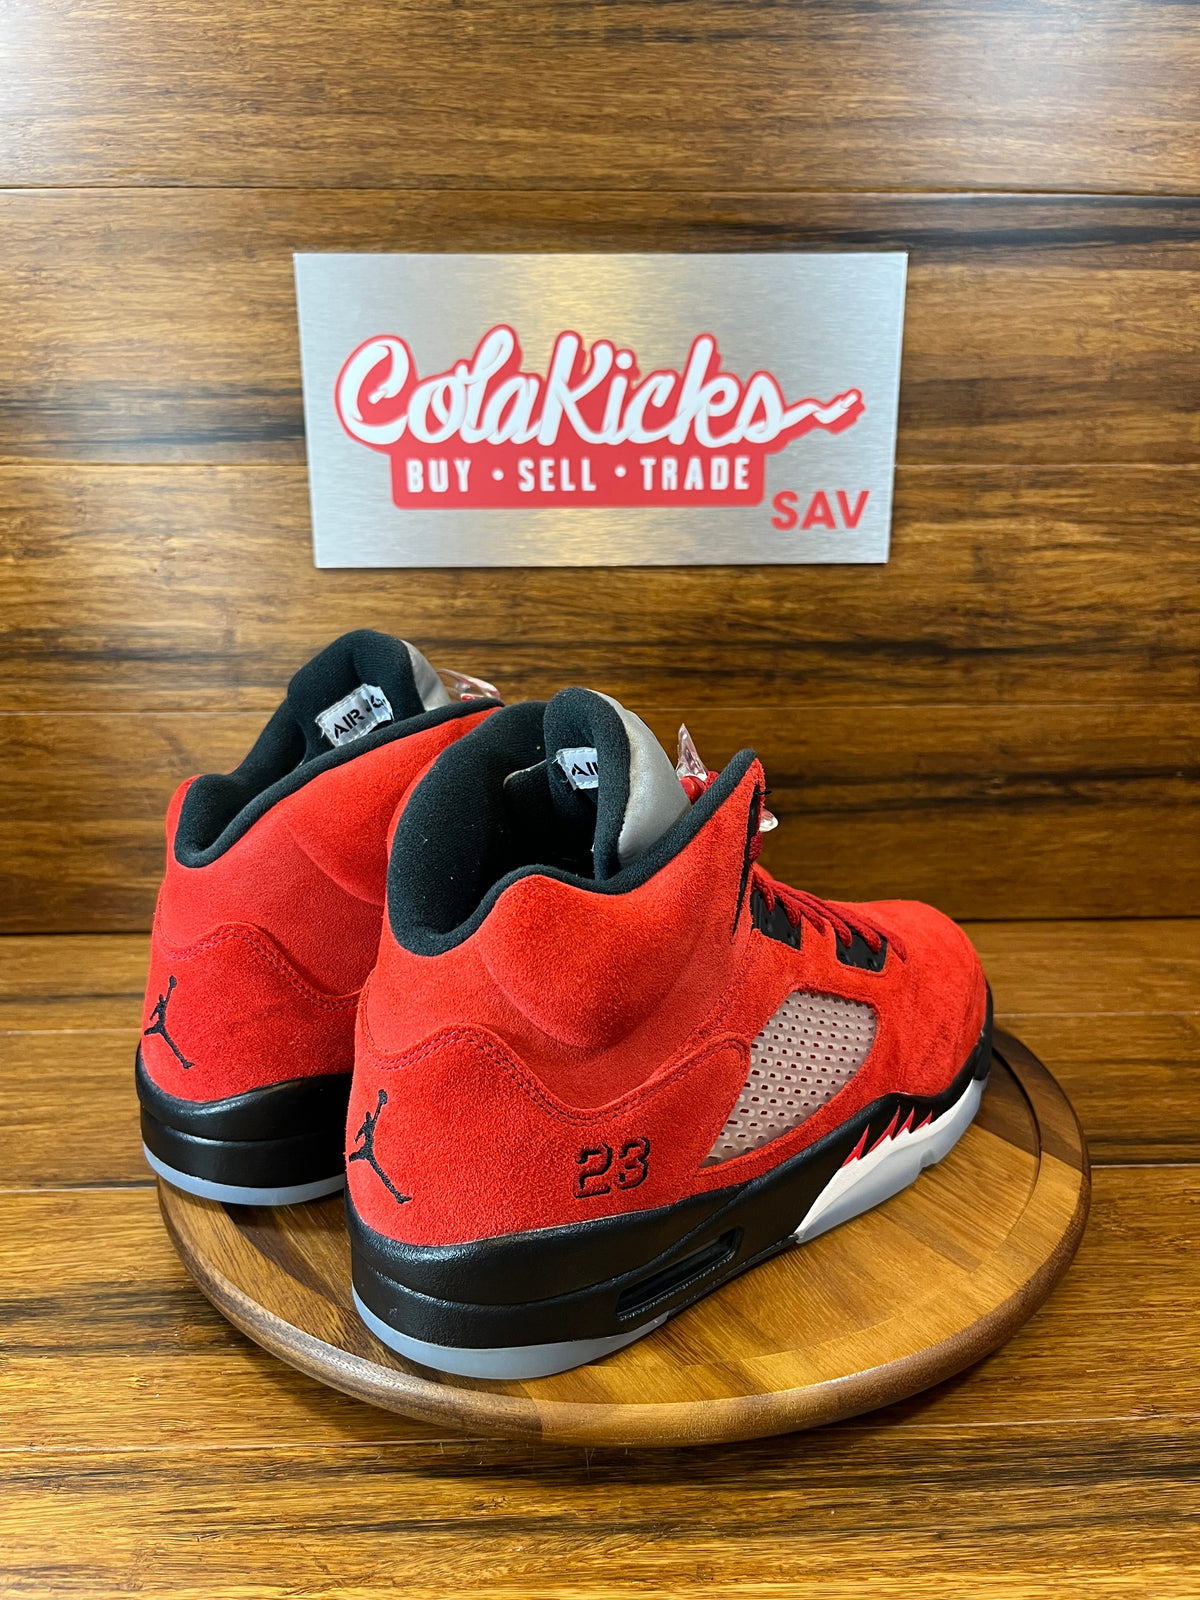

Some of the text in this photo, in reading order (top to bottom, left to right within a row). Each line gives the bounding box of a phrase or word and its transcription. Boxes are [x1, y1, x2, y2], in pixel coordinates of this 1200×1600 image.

[337, 325, 863, 448] ColaKicks
[406, 456, 750, 493] BUY SELL TRADE
[771, 489, 870, 531] SAV
[334, 708, 365, 739] AIR
[573, 1136, 651, 1199] 23
